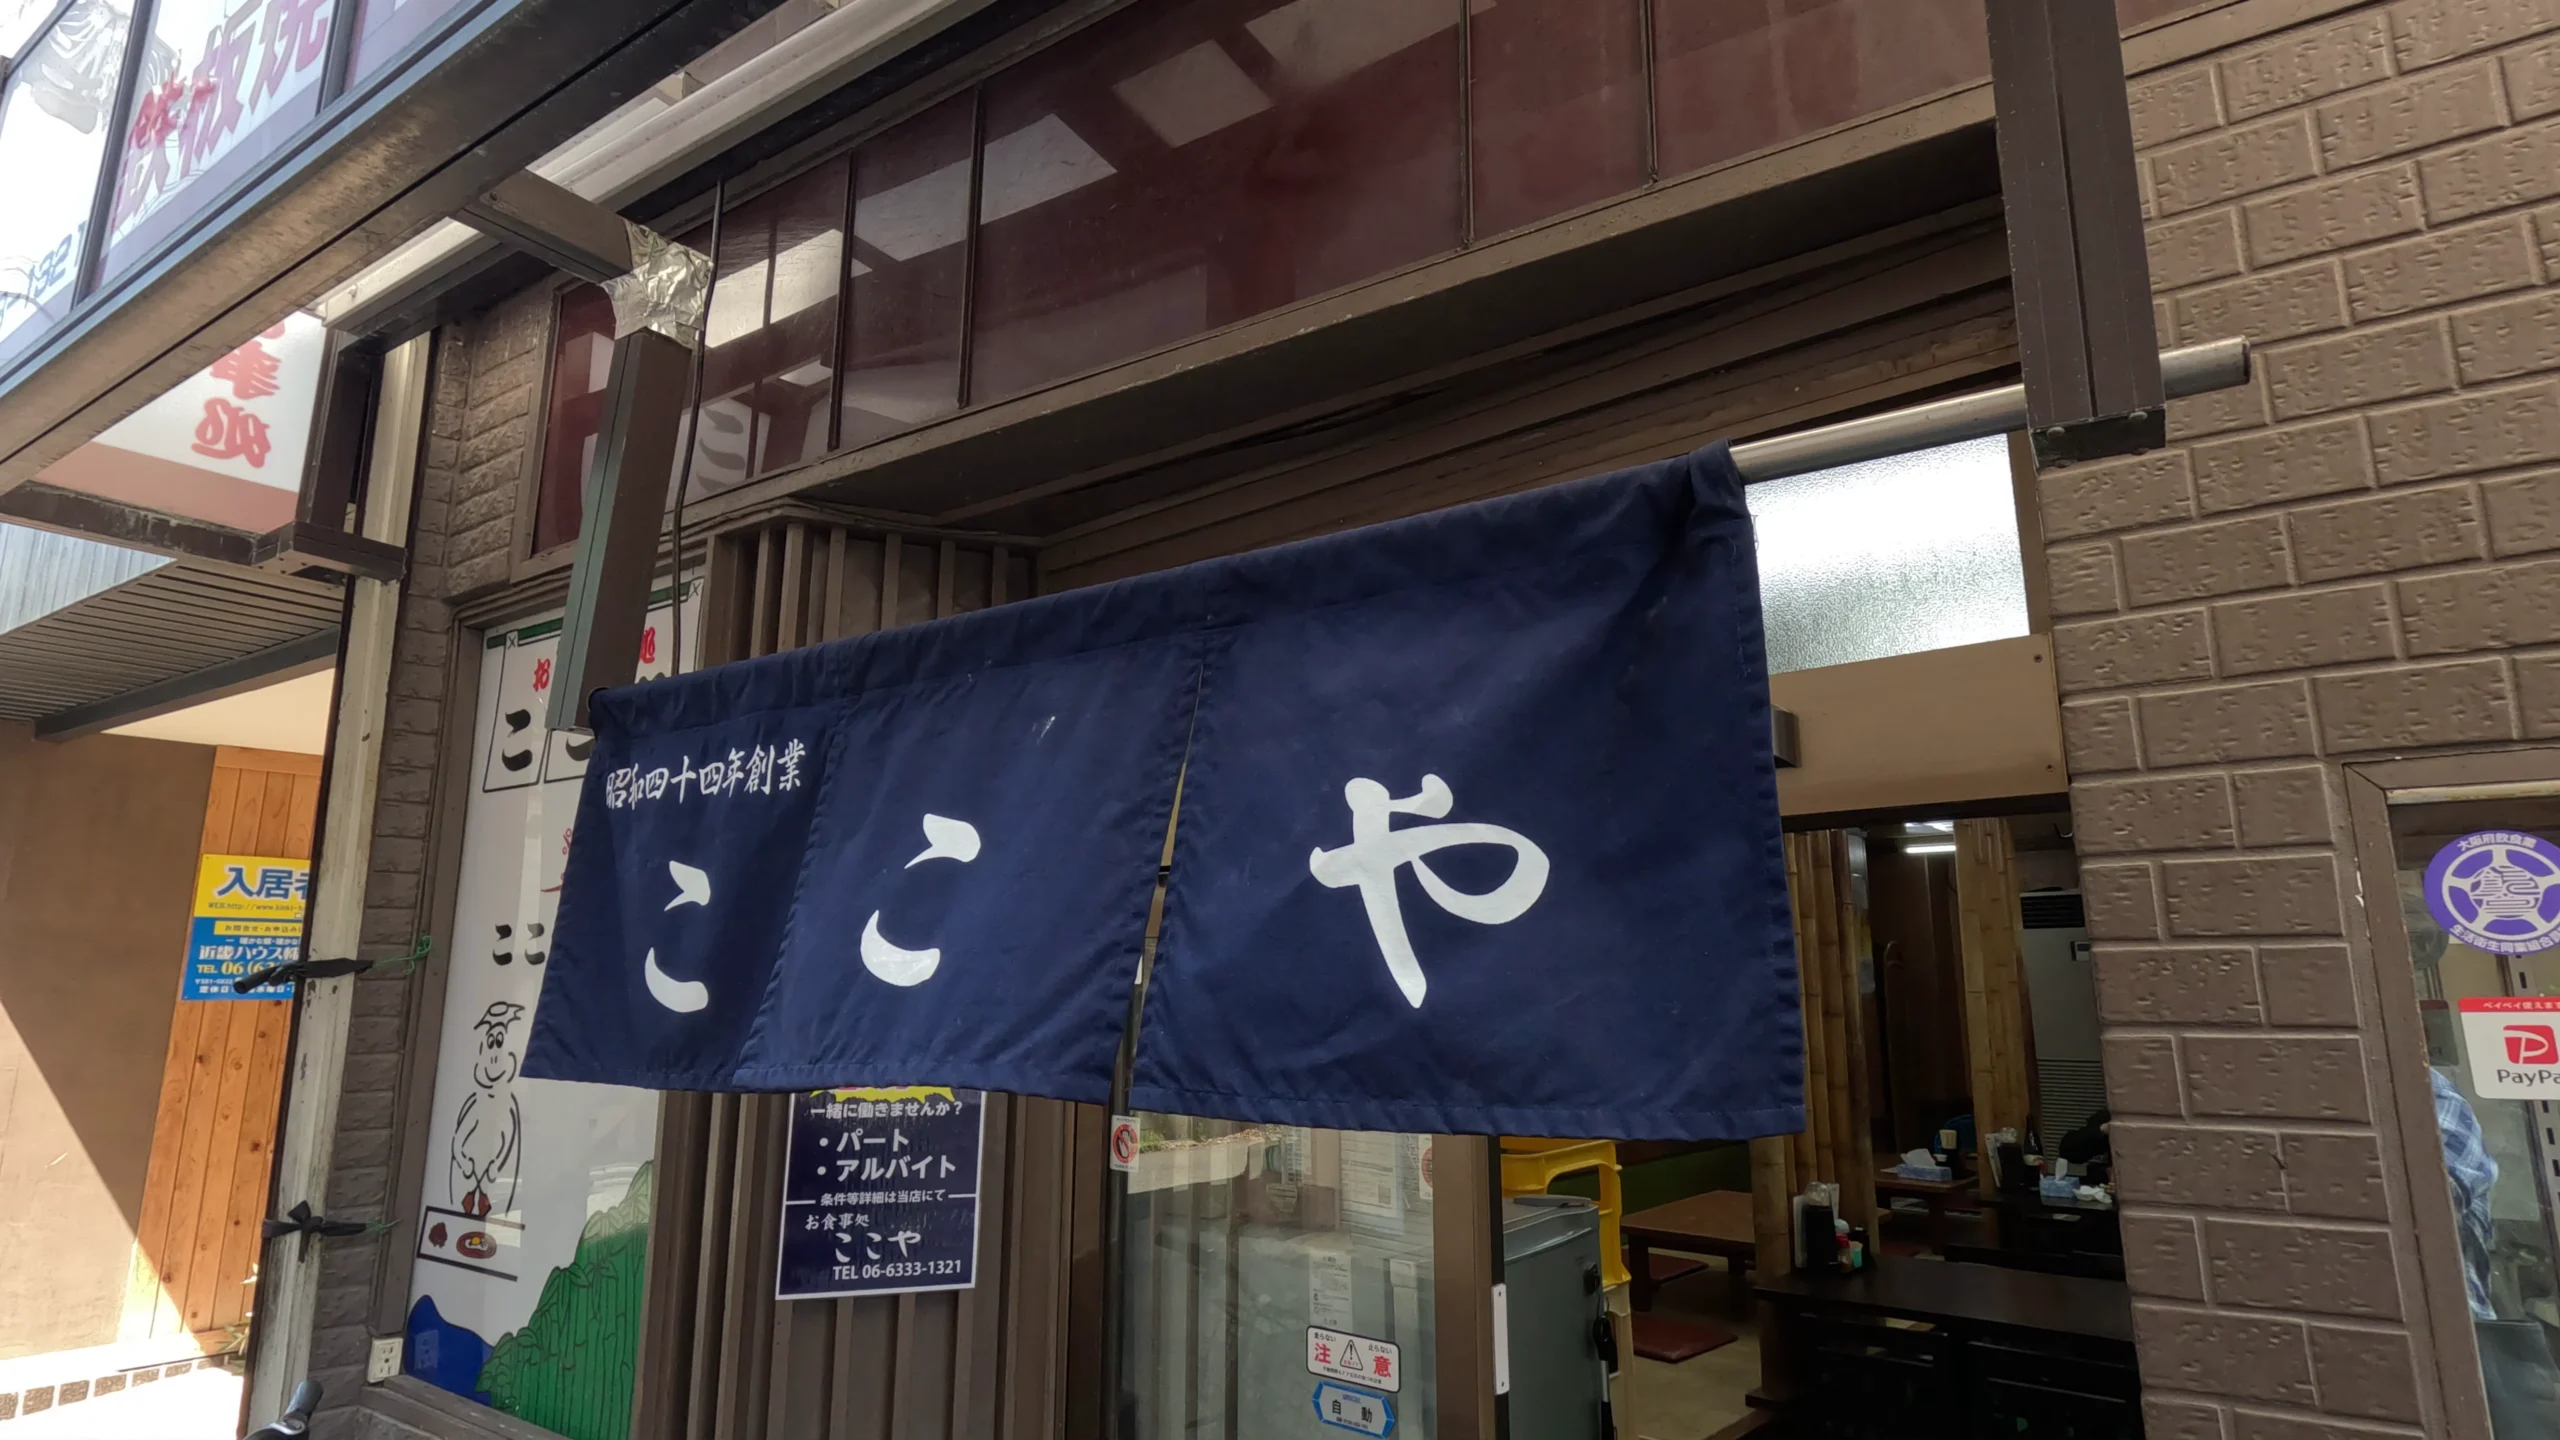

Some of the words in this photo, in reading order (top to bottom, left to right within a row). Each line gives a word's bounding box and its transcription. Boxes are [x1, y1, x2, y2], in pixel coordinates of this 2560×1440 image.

[606, 738, 806, 810] 昭和四十四年創業
[820, 1189, 946, 1207] 条件等詳細は当店にて
[805, 1213, 870, 1230] お食事処
[835, 1230, 921, 1263] ここや
[833, 1265, 858, 1280] TEL
[862, 1259, 961, 1279] 06-6333-1321
